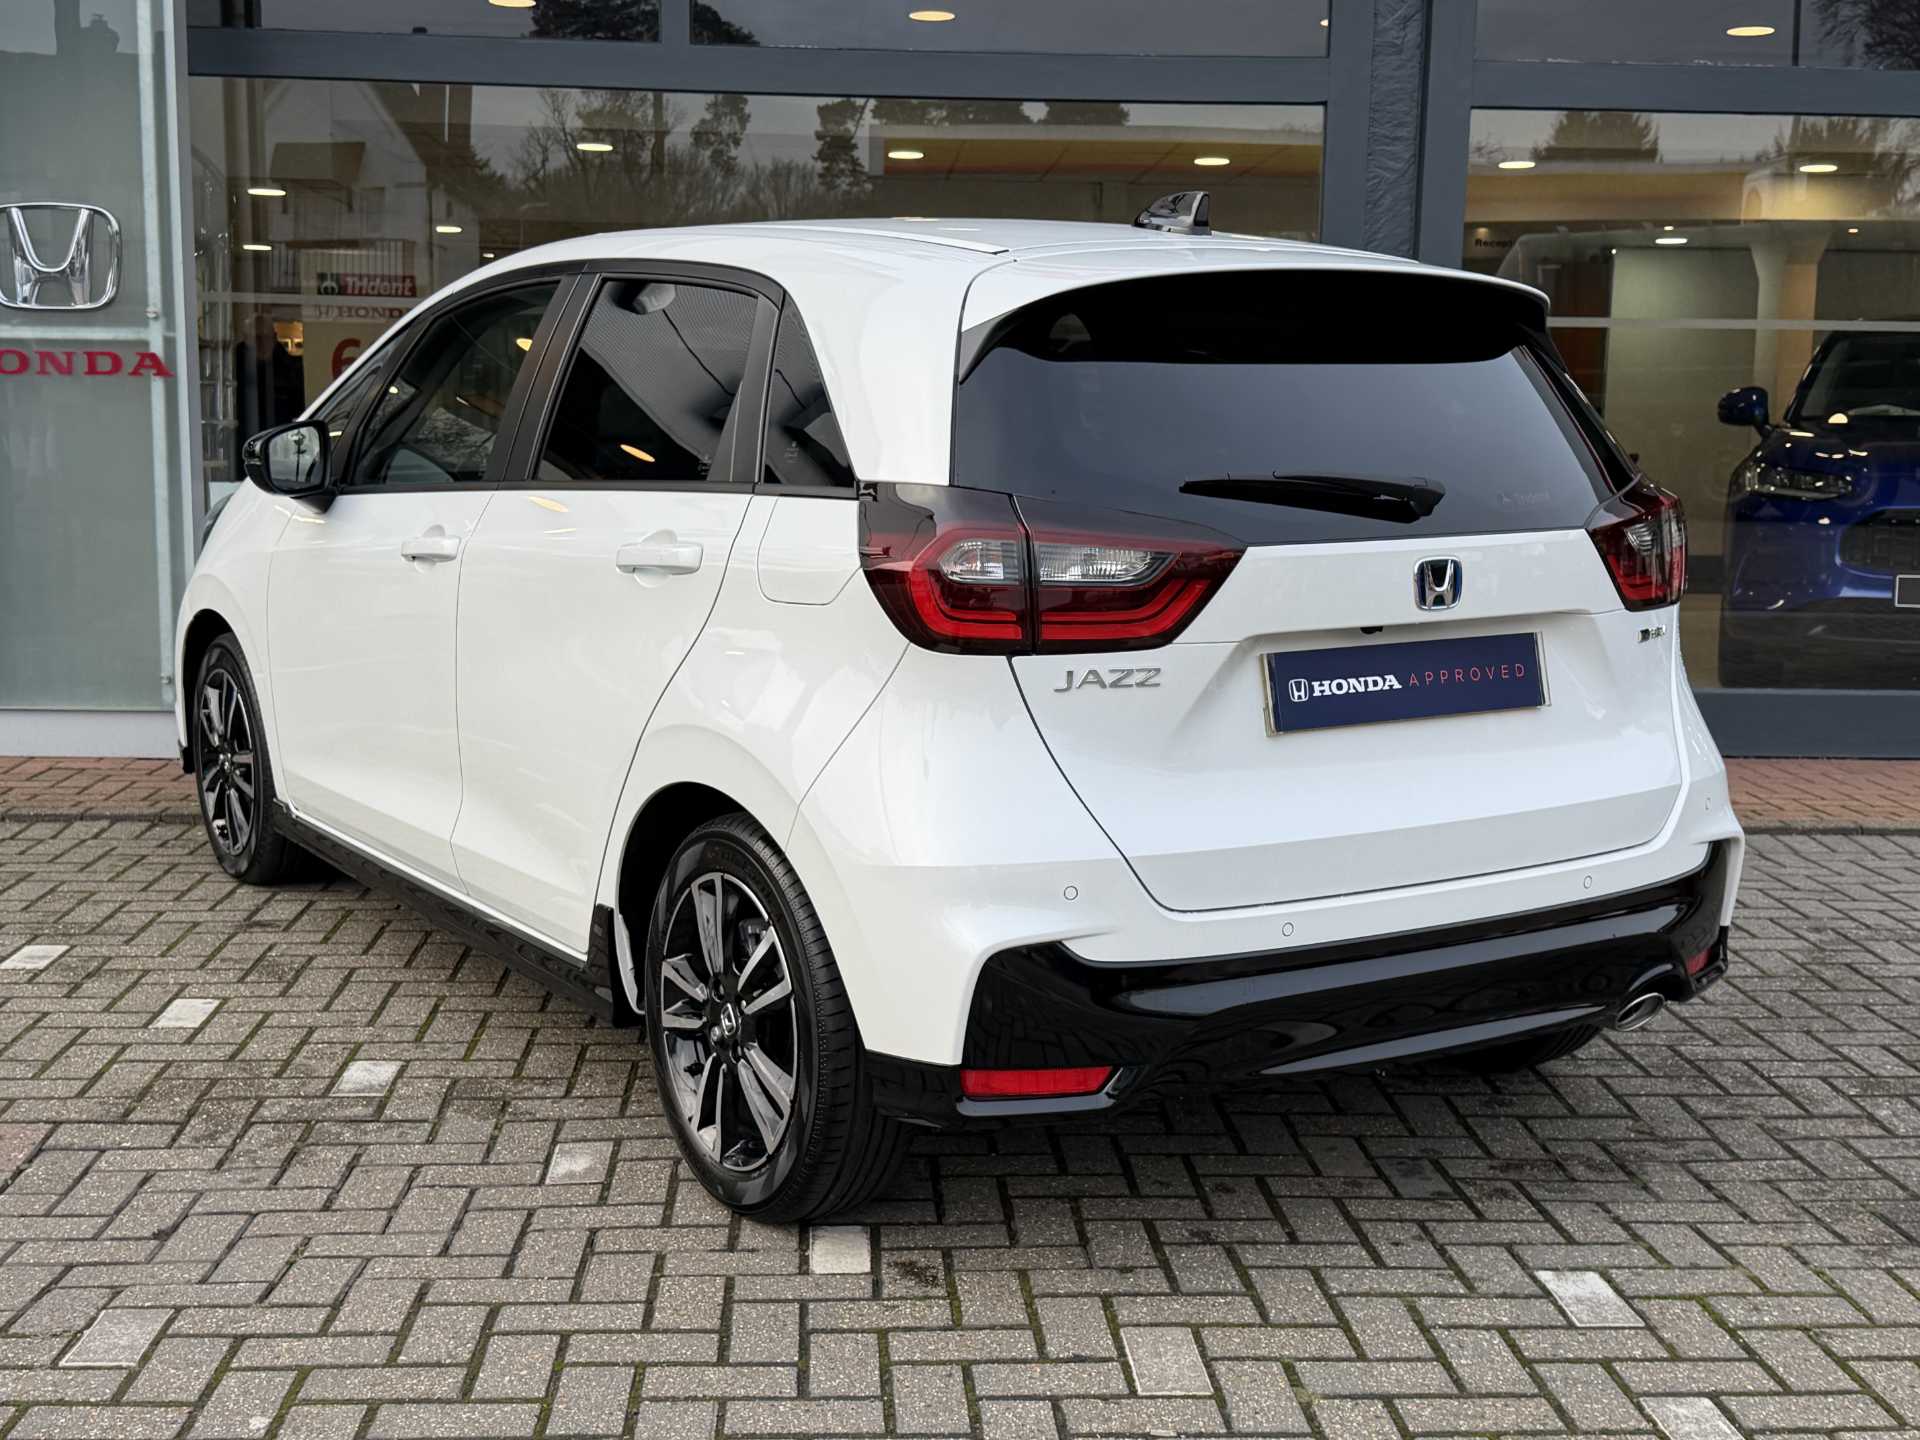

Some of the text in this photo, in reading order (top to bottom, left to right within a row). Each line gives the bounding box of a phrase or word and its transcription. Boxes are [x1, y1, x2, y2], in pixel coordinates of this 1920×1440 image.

[337, 305, 403, 318] HOND
[1053, 667, 1161, 693] JAZZ
[1311, 674, 1402, 697] HONDA
[1409, 663, 1526, 687] APPROVED
